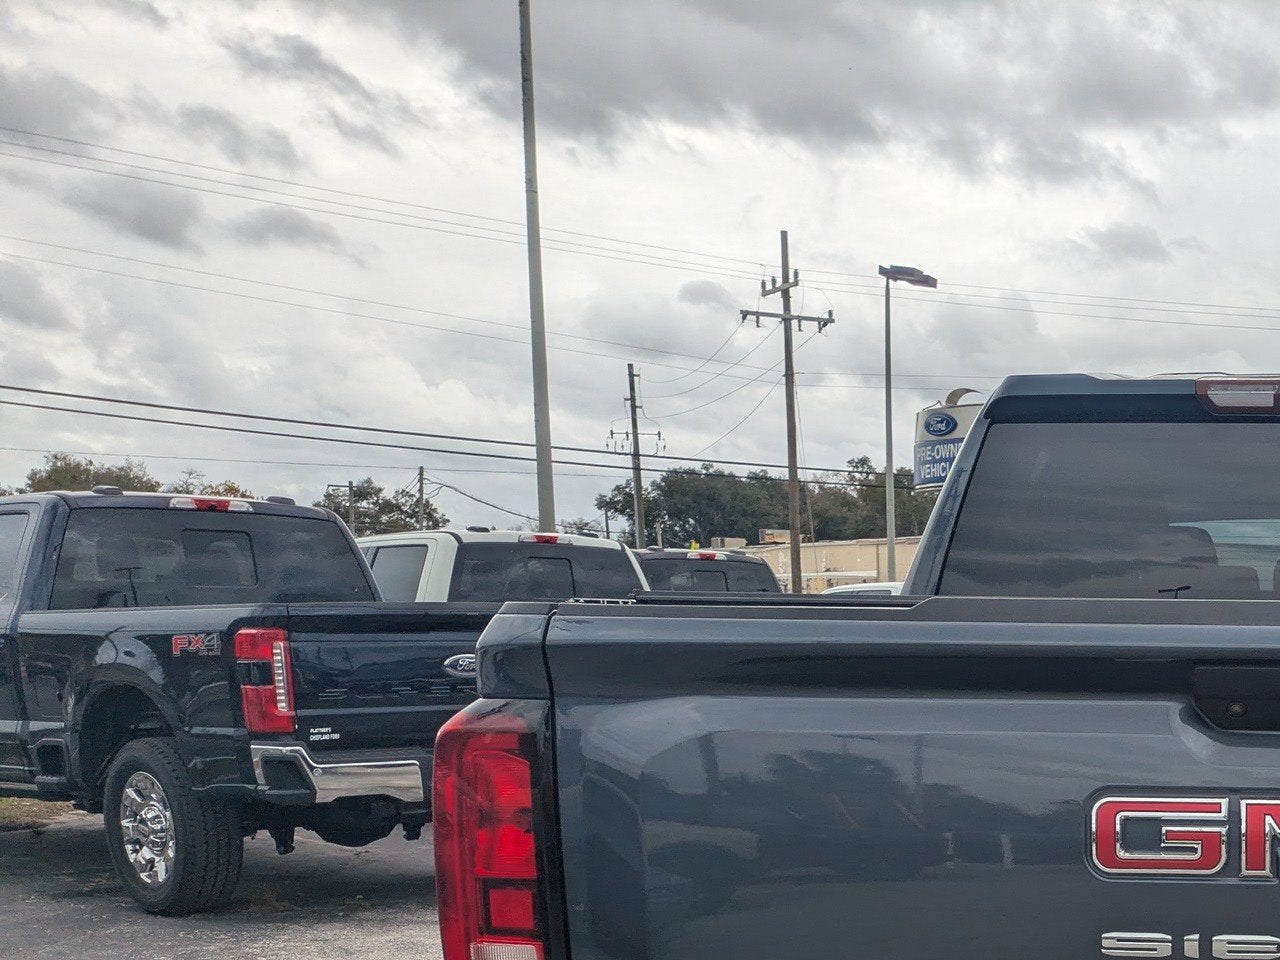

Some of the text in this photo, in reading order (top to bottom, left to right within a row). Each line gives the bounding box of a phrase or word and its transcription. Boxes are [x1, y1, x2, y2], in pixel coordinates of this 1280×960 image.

[927, 417, 947, 431] Ford
[172, 632, 221, 657] FX4
[456, 658, 477, 671] For
